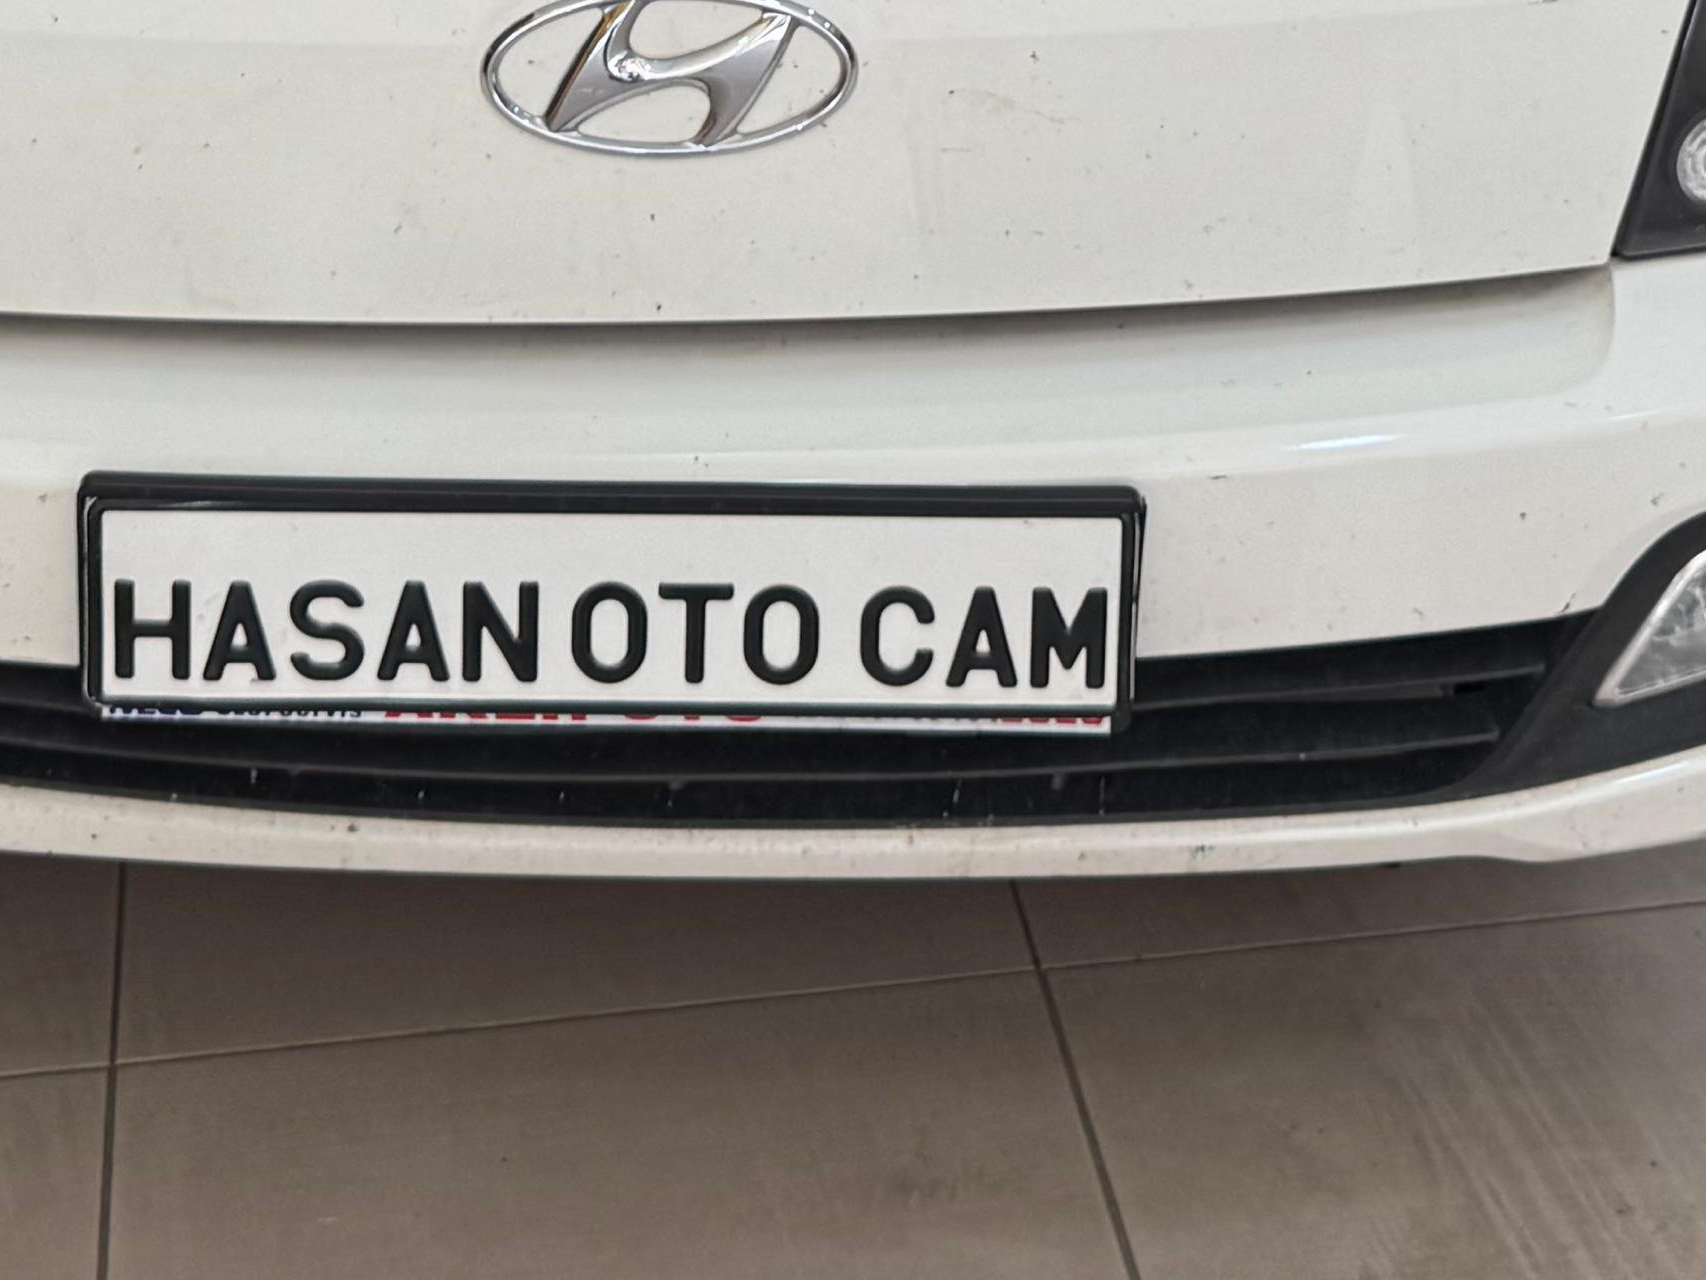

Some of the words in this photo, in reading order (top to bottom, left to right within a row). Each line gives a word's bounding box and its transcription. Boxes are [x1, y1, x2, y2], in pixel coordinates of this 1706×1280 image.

[113, 579, 540, 683] HASAN
[570, 582, 821, 685] OTO
[859, 586, 1109, 689] CAM
